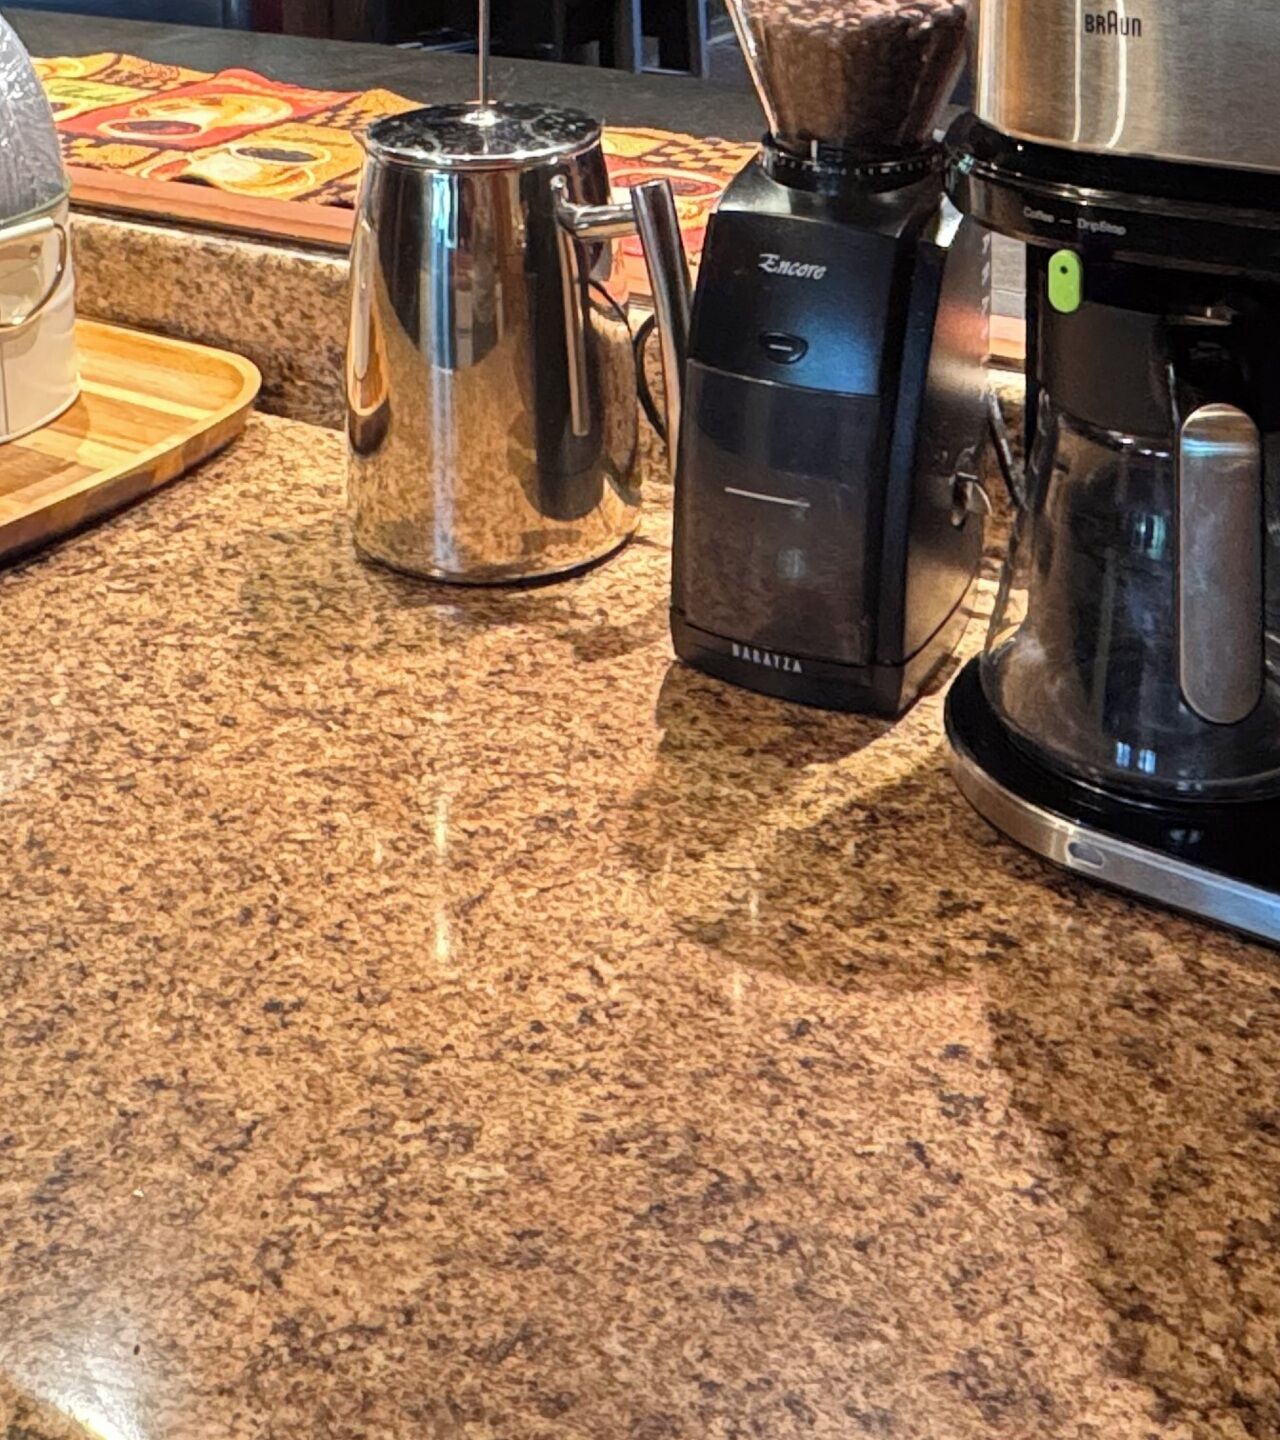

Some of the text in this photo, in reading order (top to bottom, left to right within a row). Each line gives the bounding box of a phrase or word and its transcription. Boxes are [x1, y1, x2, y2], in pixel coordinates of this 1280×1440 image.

[1085, 10, 1142, 37] BRAUN
[1023, 206, 1127, 236] Coffee DripStop
[758, 253, 827, 280] Encore
[732, 642, 802, 673] BARATZA
